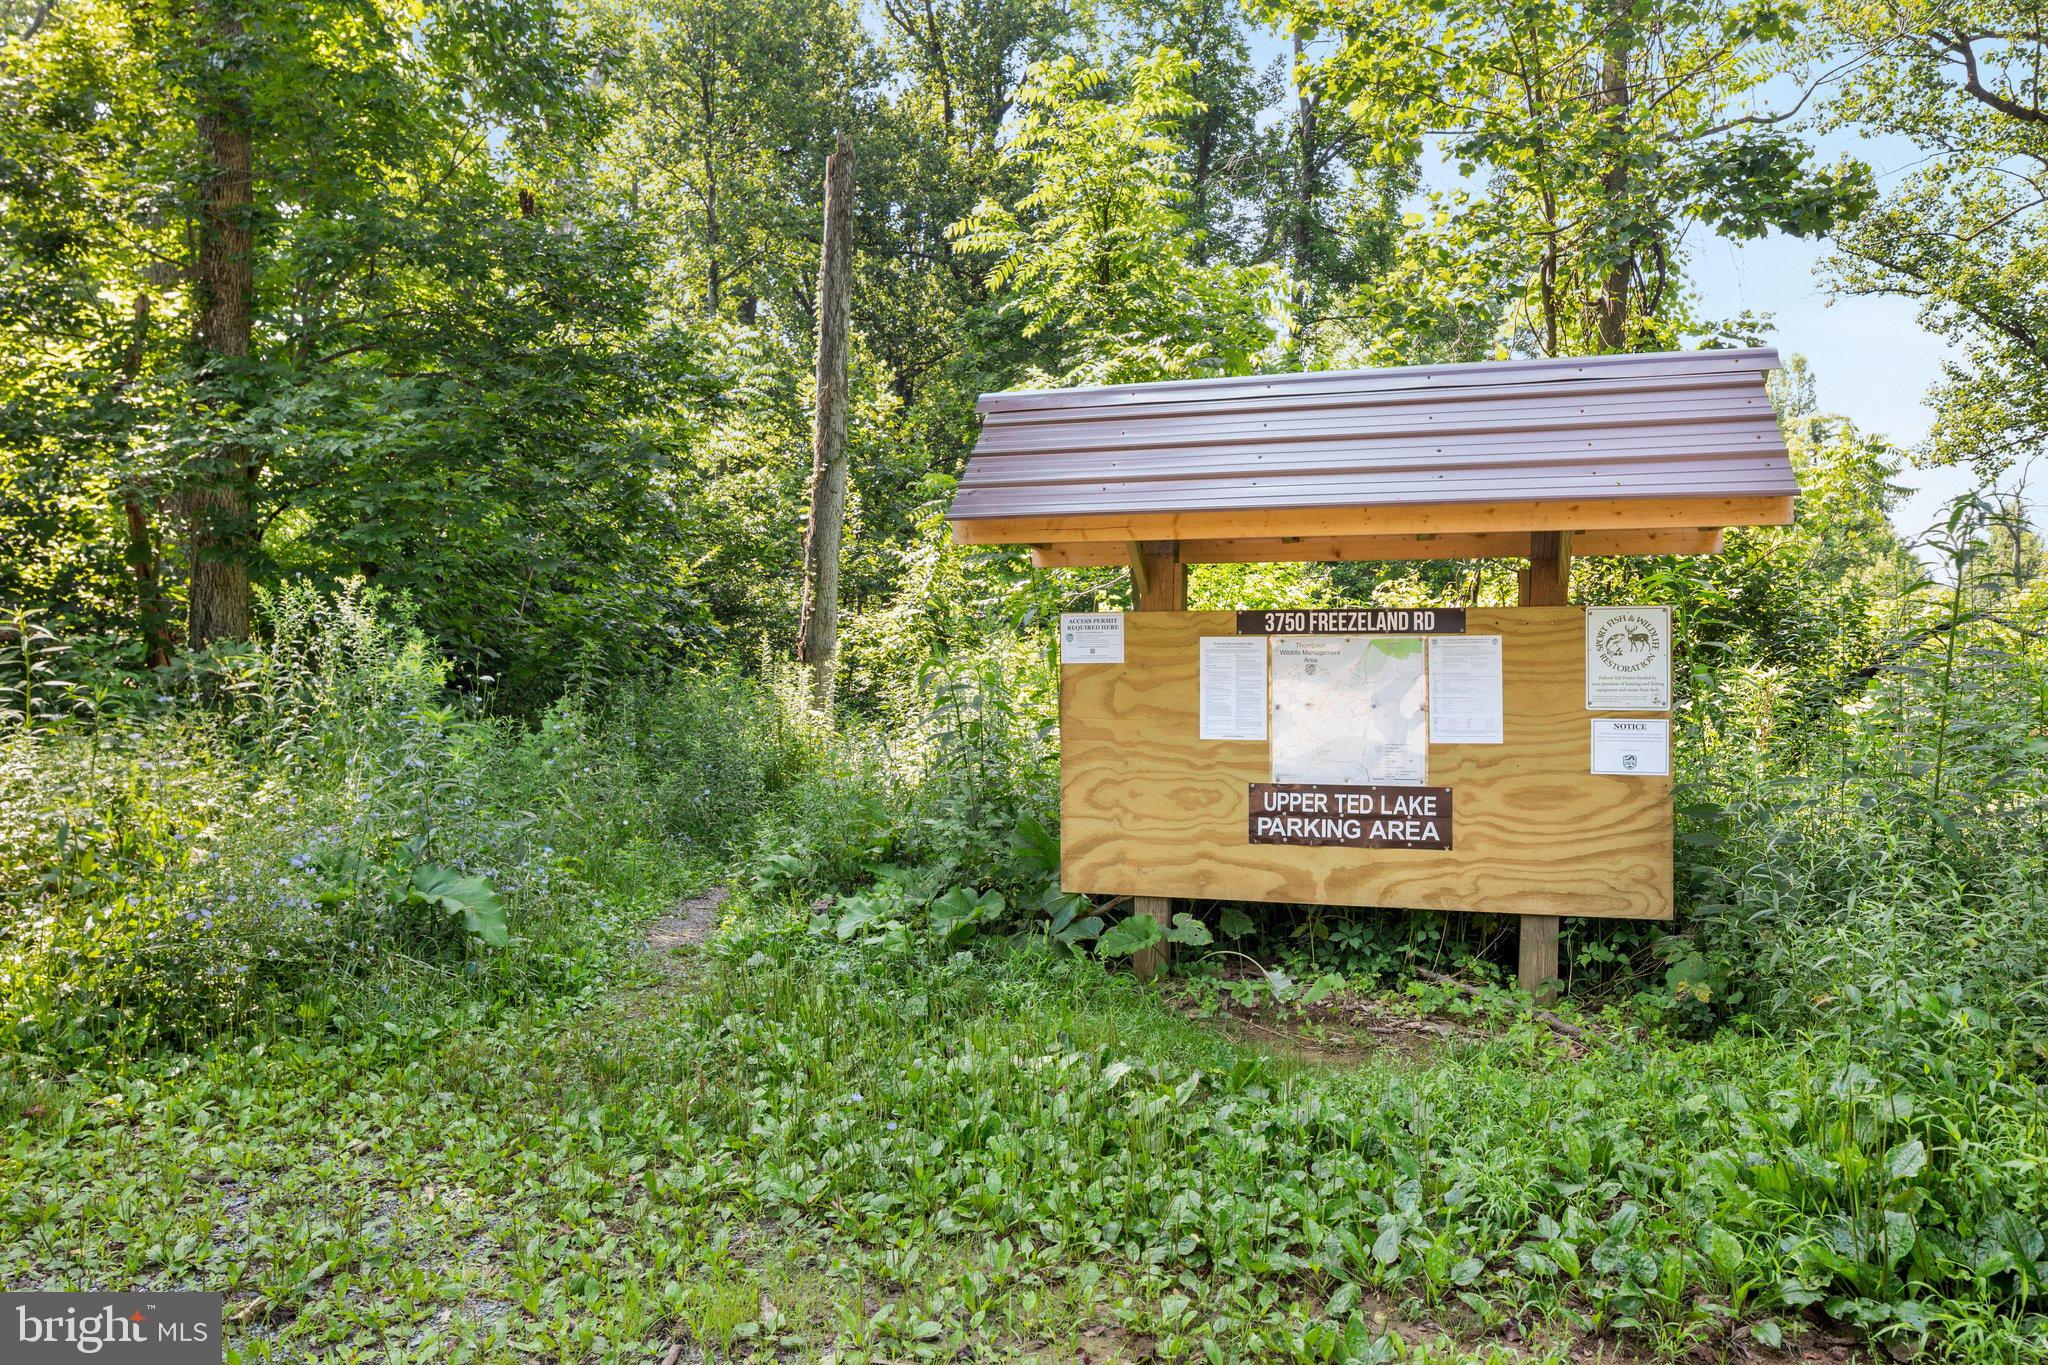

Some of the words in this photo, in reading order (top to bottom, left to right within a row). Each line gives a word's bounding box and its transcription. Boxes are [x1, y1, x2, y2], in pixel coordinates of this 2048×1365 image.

[1265, 612, 1305, 632] 3750
[1310, 611, 1409, 631] FREEZELAND
[1414, 611, 1435, 631] RD
[1596, 625, 1608, 652] SPORT
[1606, 615, 1626, 627] FISH
[1637, 616, 1660, 651] WILDLIFE
[1302, 649, 1341, 657] Management
[1599, 652, 1656, 673] RESTORATION
[1264, 791, 1328, 813] UPPER
[1334, 793, 1374, 814] TED
[1380, 795, 1437, 816] LAKE
[1257, 817, 1361, 839] PARKING
[1368, 820, 1441, 841] AREA
